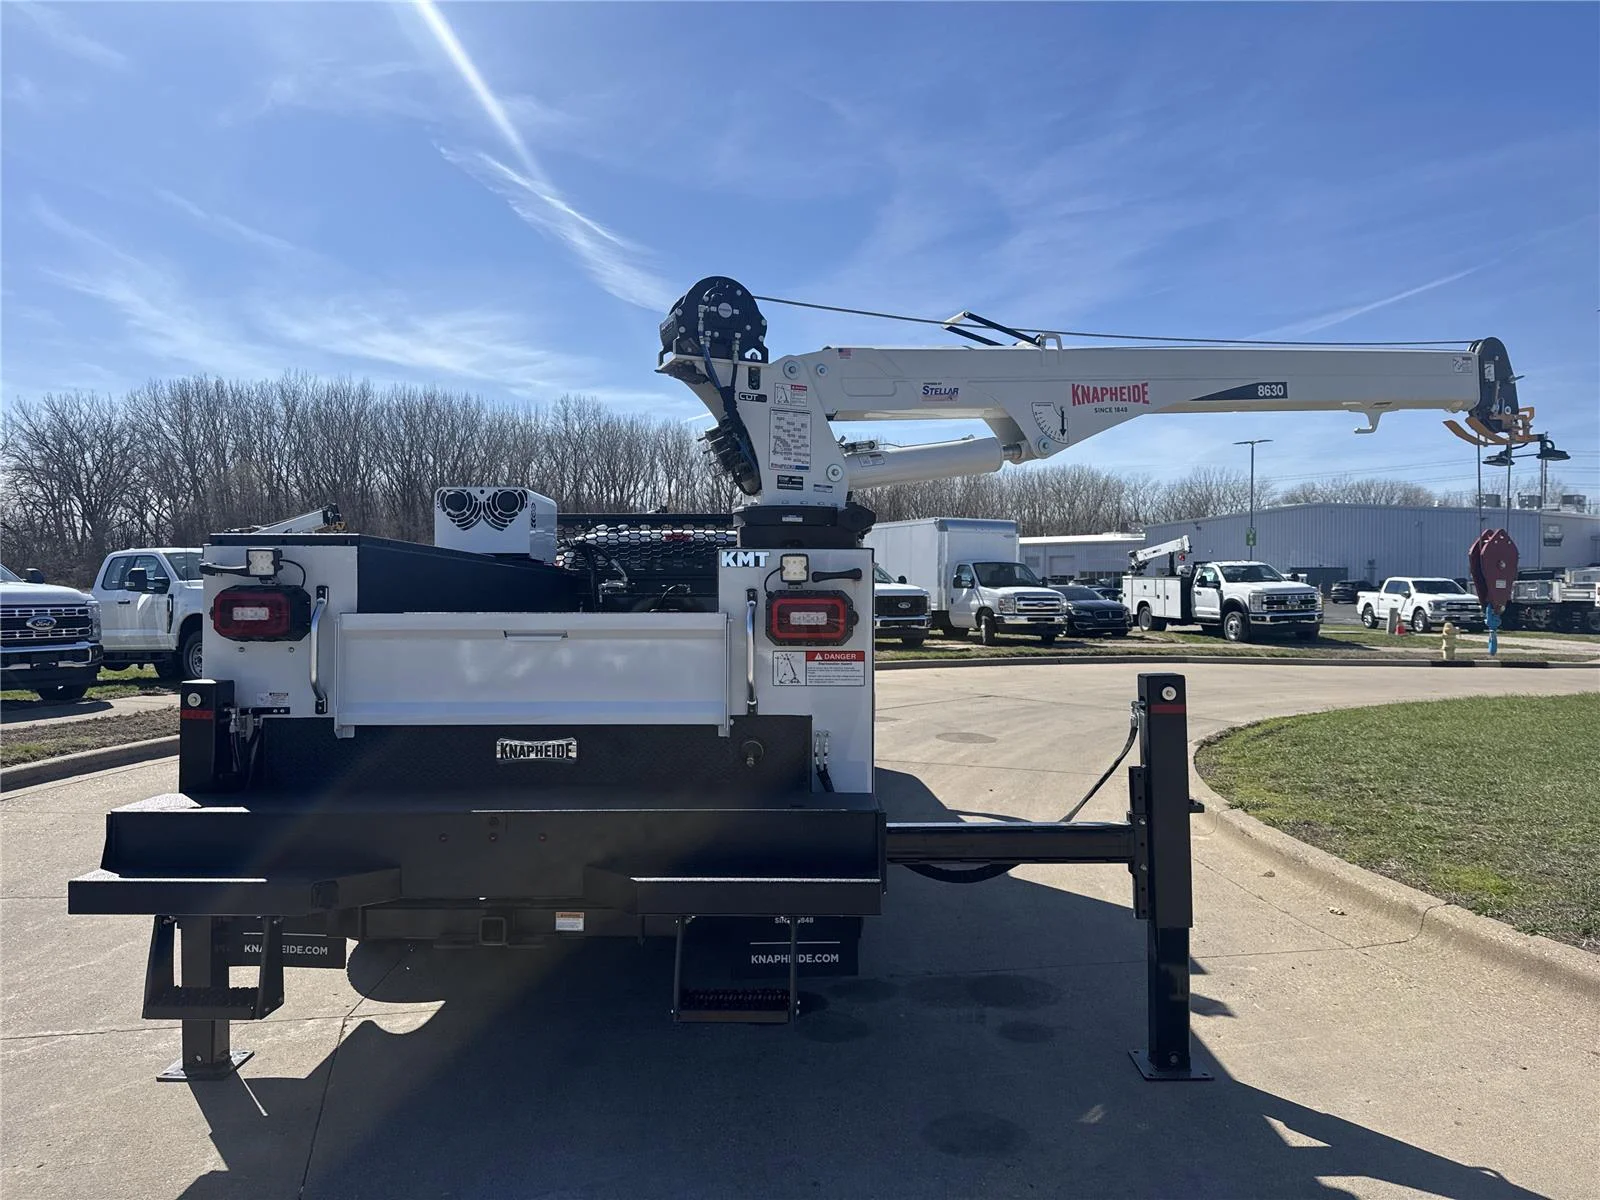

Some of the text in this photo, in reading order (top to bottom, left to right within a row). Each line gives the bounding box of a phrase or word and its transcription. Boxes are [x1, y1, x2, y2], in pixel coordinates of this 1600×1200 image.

[739, 393, 758, 401] CDT
[922, 385, 959, 396] STELLAR
[1071, 382, 1150, 406] KNAPHEIDE
[1257, 384, 1284, 397] 8630
[721, 551, 770, 567] KMT
[500, 741, 573, 760] KNAPHEIDE
[751, 953, 839, 964] KNAPHIDE.COM
